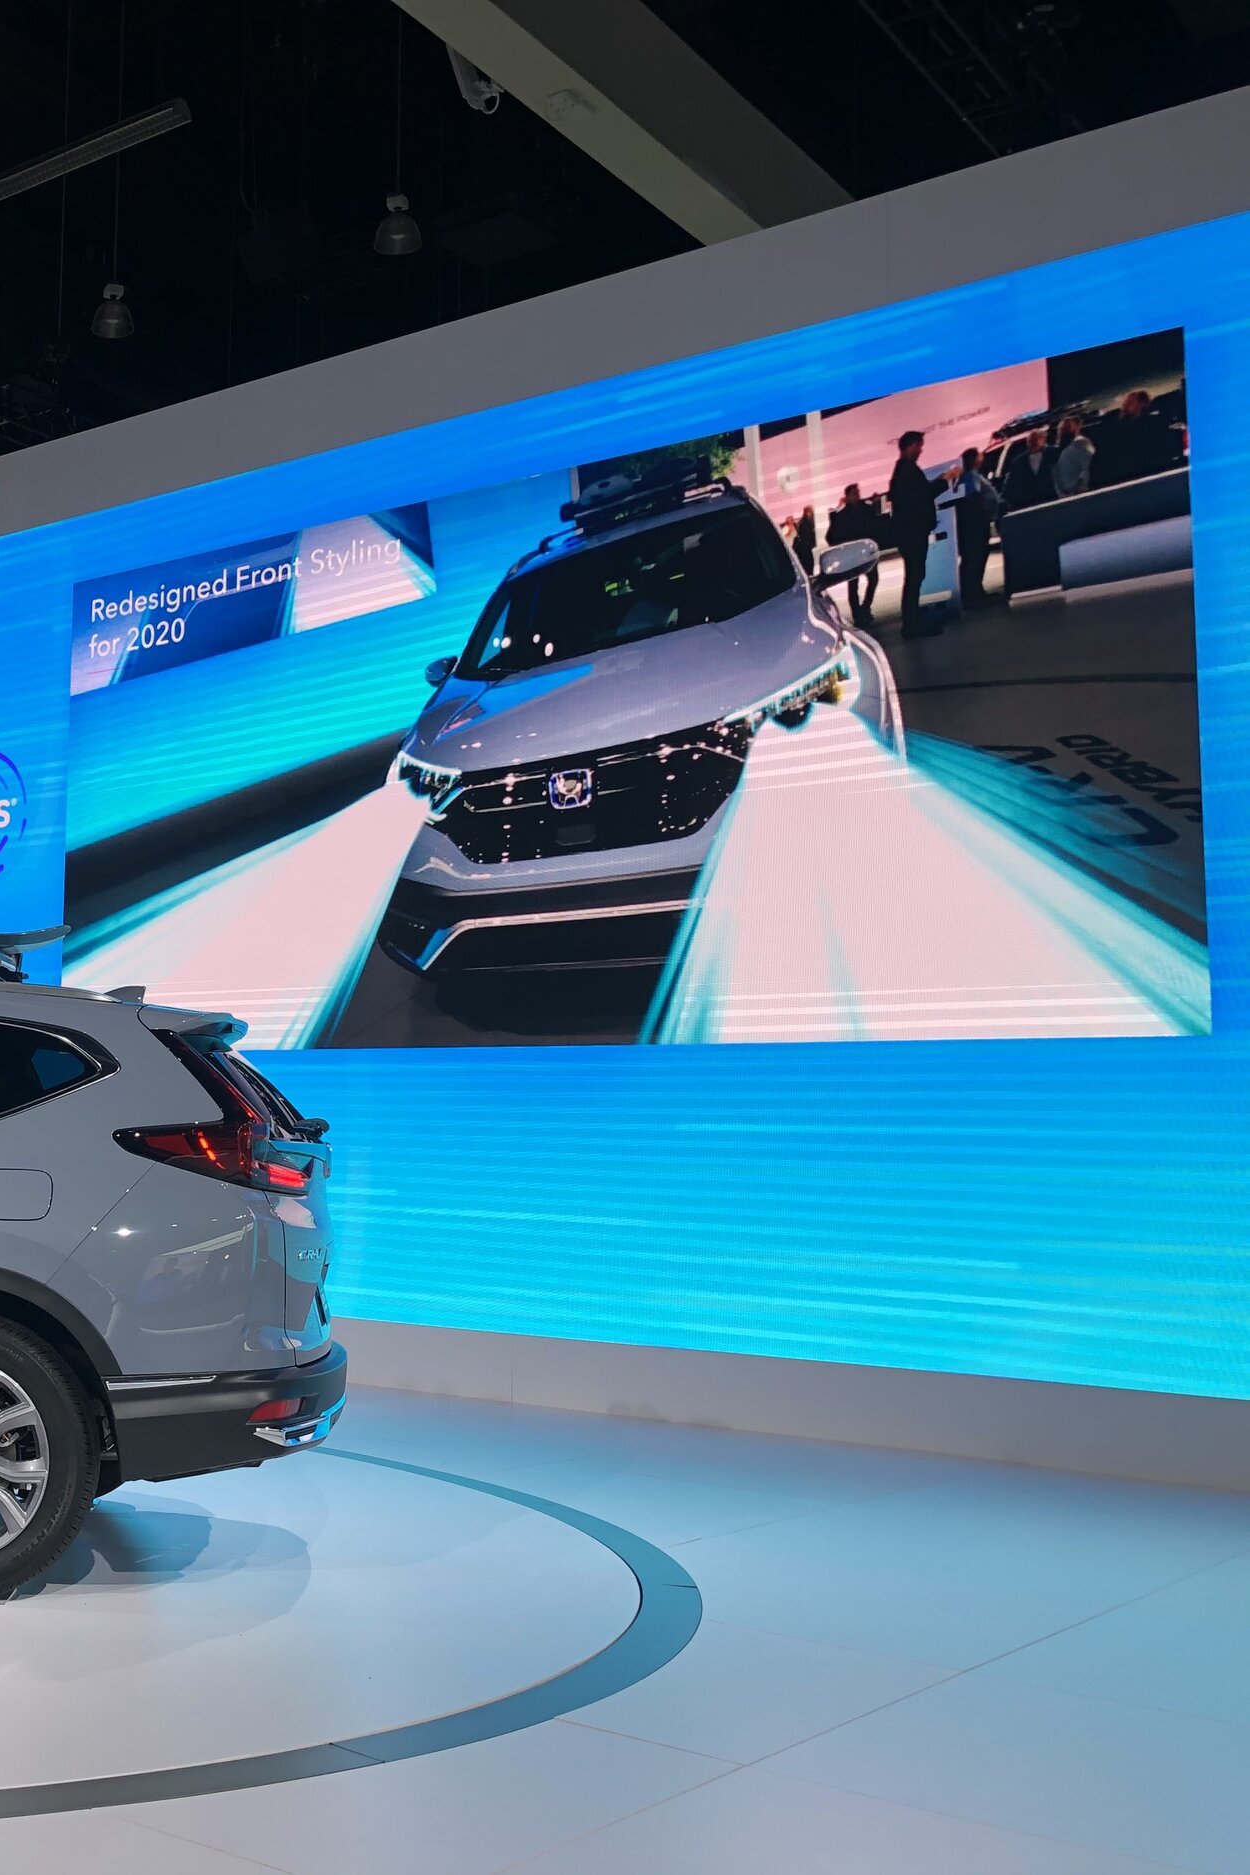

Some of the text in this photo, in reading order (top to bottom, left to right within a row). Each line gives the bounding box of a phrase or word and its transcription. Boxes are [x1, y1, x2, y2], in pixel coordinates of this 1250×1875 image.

[91, 538, 402, 622] Redesigned Front Styling
[88, 617, 186, 659] for 2020
